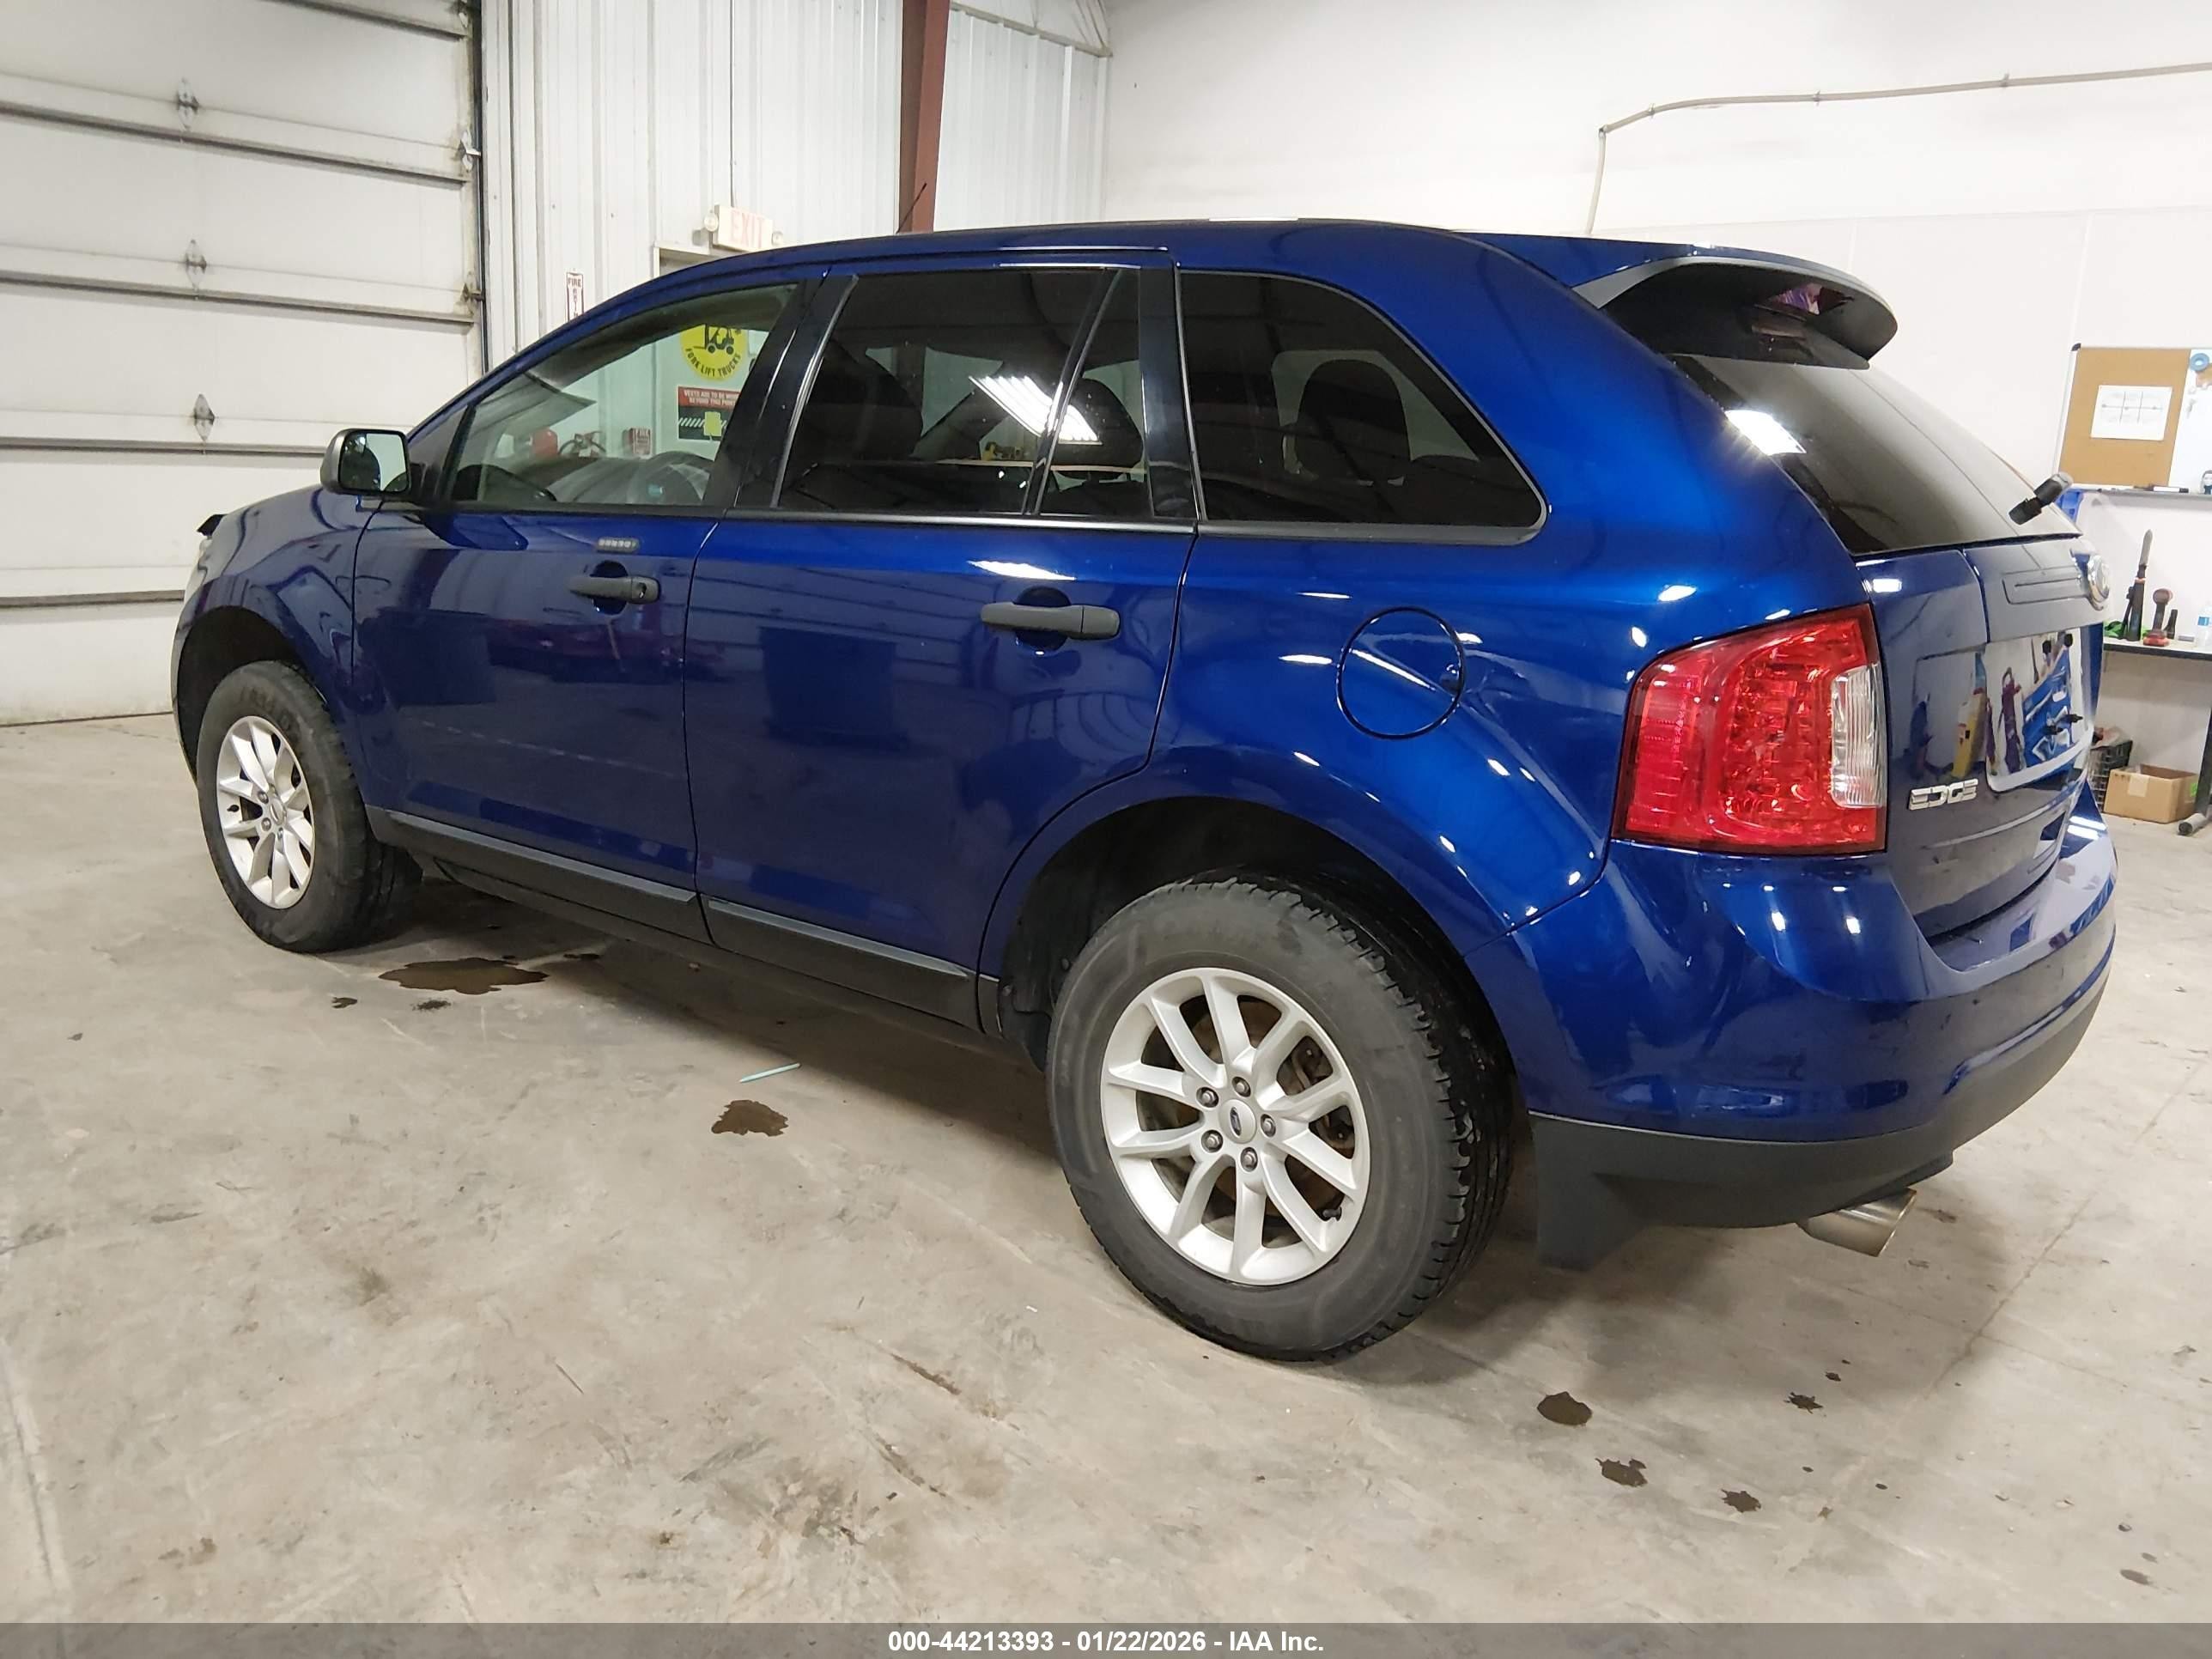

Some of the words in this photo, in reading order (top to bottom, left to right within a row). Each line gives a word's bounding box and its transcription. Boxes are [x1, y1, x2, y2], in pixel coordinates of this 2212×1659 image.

[730, 209, 767, 249] EXIT
[568, 277, 581, 288] FIRE
[700, 364, 715, 377] LIFT
[717, 352, 741, 378] TRUCKS
[1909, 778, 1978, 811] EDGE
